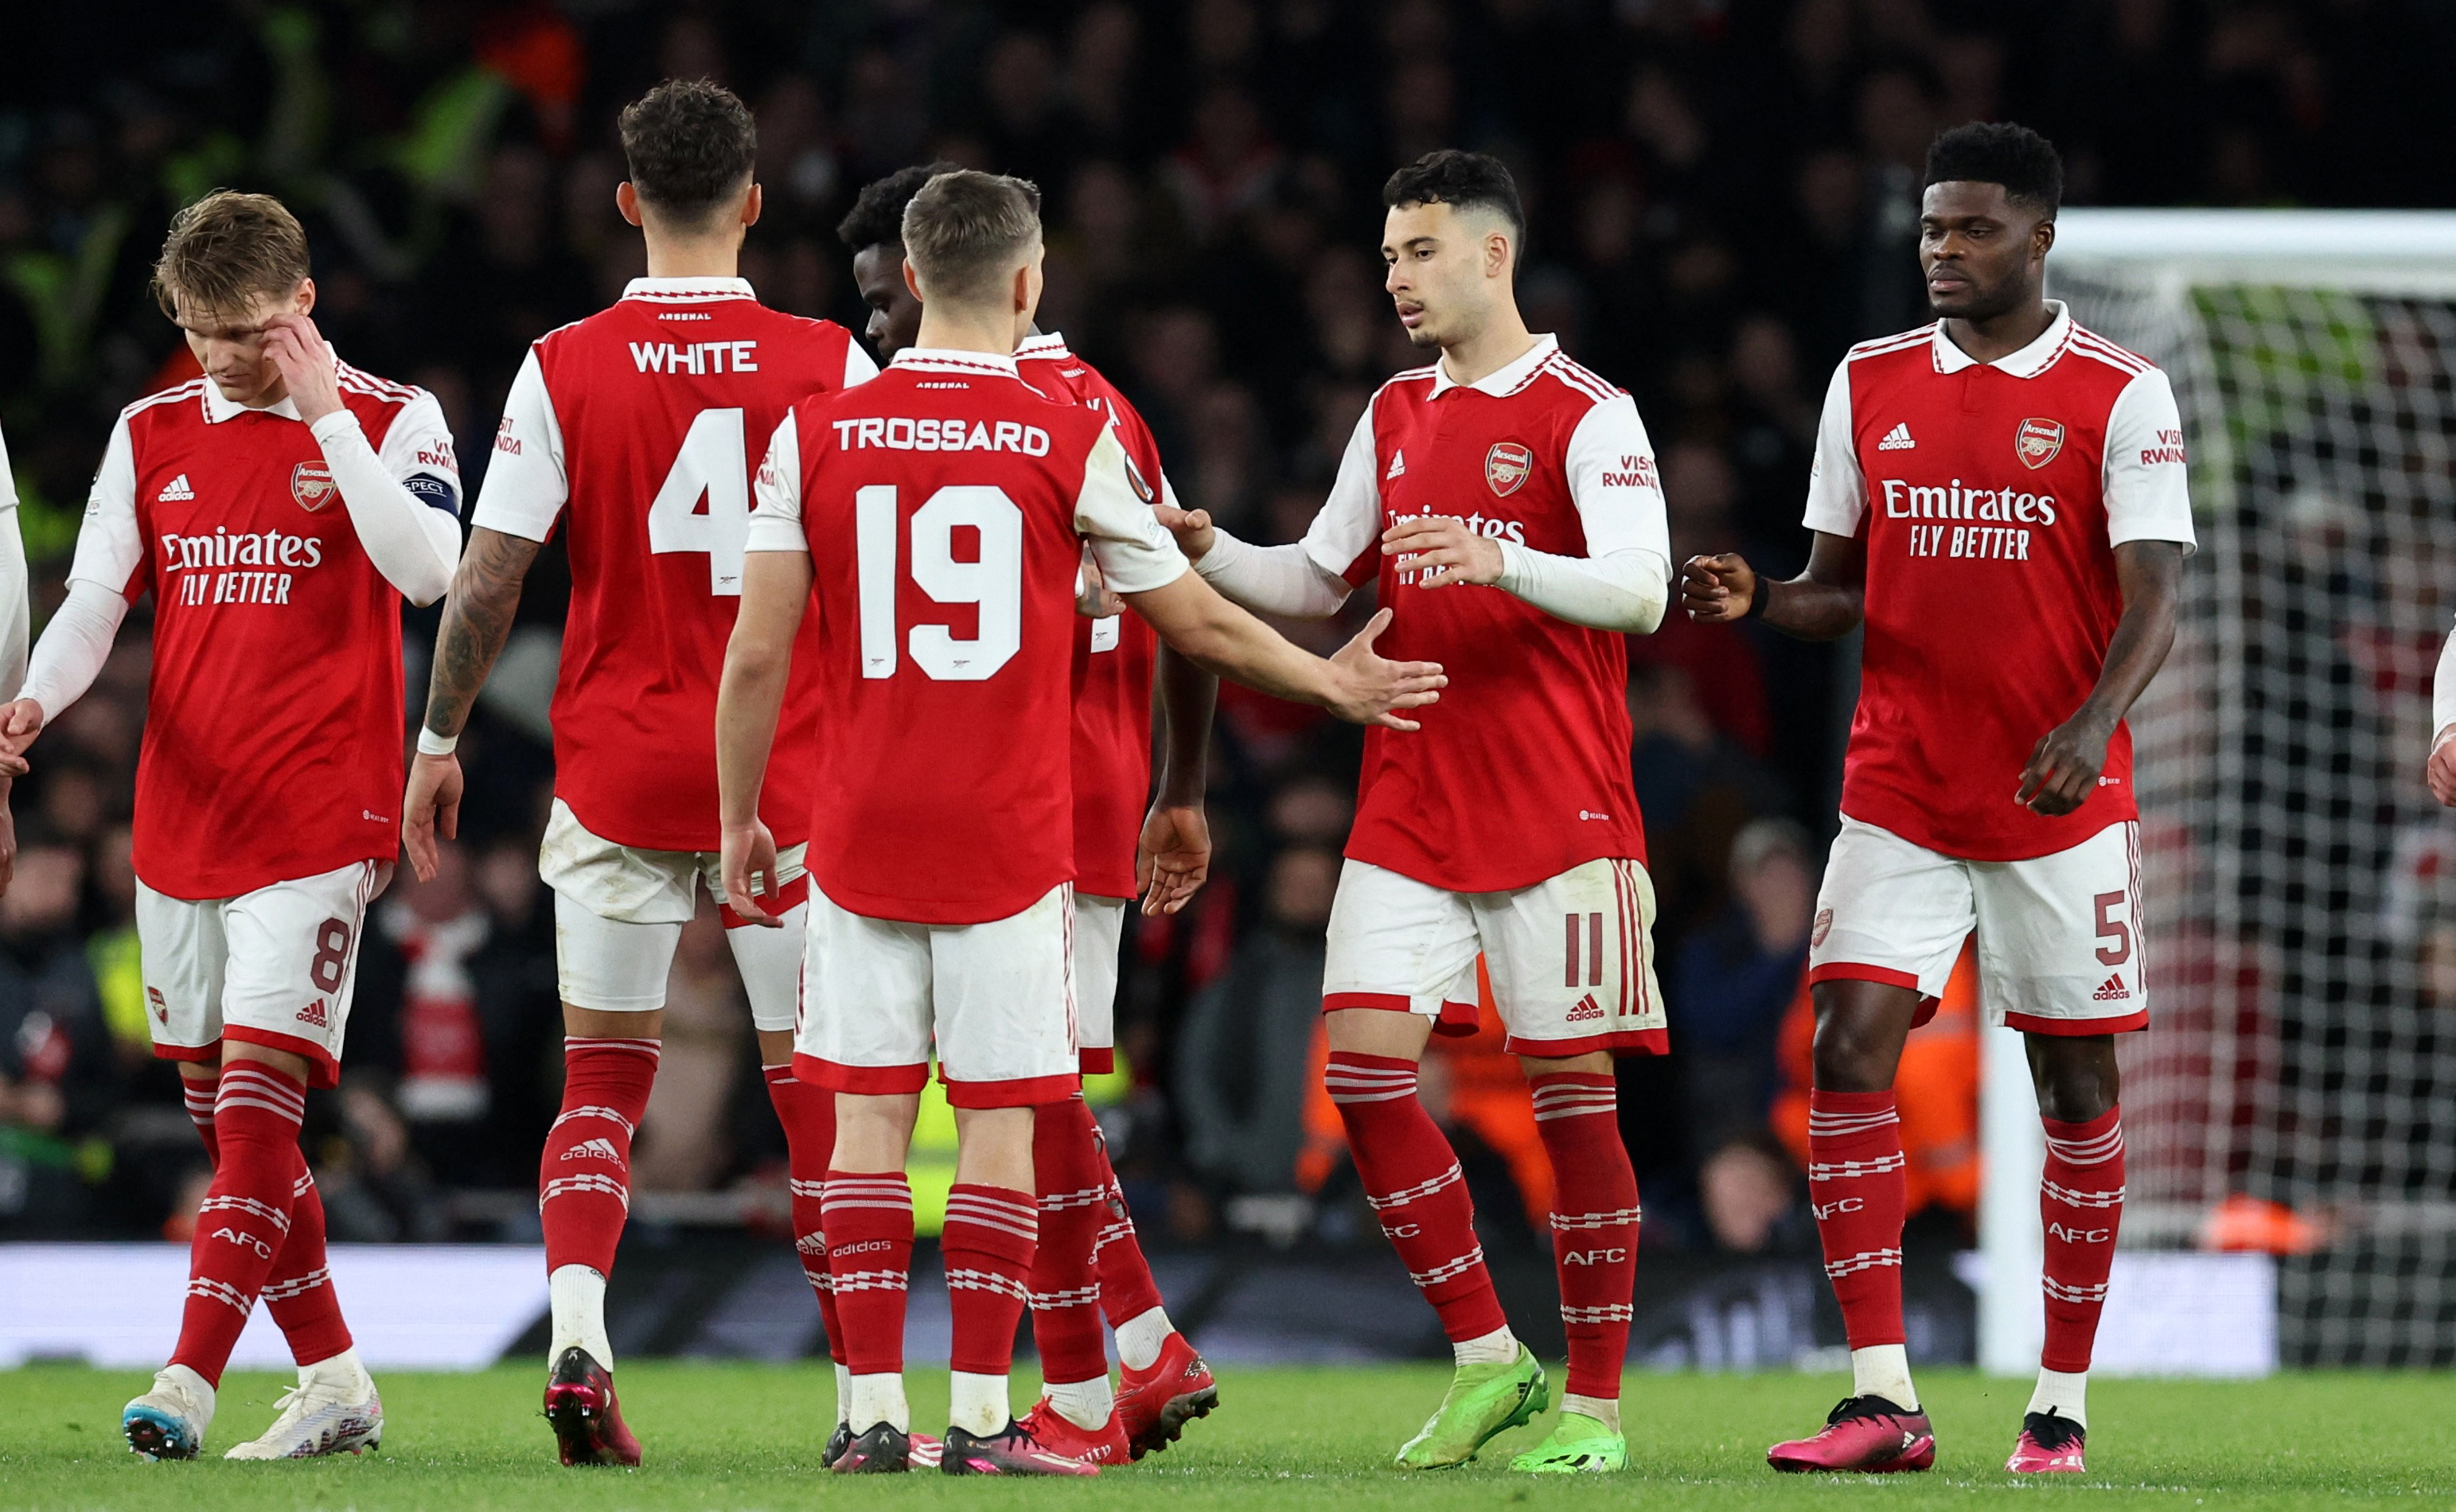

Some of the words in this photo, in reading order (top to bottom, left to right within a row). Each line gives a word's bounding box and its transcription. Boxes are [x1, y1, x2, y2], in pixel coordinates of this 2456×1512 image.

[628, 341, 758, 375] WHITE
[832, 417, 1051, 458] TROSSARD
[2024, 424, 2057, 438] Arsenal
[1878, 438, 1916, 451] adidas
[158, 490, 195, 502] adidas
[403, 481, 443, 494] SPECT
[648, 407, 750, 596] 4
[1881, 478, 2056, 526] Emirates
[161, 525, 322, 571] Emirates
[1909, 524, 1944, 557] FLY
[1950, 525, 2031, 561] BETTER
[213, 571, 292, 605] BETTER
[856, 485, 1023, 680] 19
[2094, 890, 2130, 967] 5
[310, 917, 350, 996] 8
[1565, 912, 1603, 988] 11
[2092, 989, 2130, 1000] adidas
[295, 1012, 327, 1028] adidas
[1565, 1009, 1604, 1022] adidas
[559, 1150, 626, 1173] adidas
[1381, 1222, 1421, 1239] FC
[2049, 1222, 2110, 1244] AFC
[211, 1227, 271, 1260] AFC
[796, 1242, 827, 1256] adid
[832, 1240, 891, 1258] adidas
[1563, 1248, 1627, 1266] AFC
